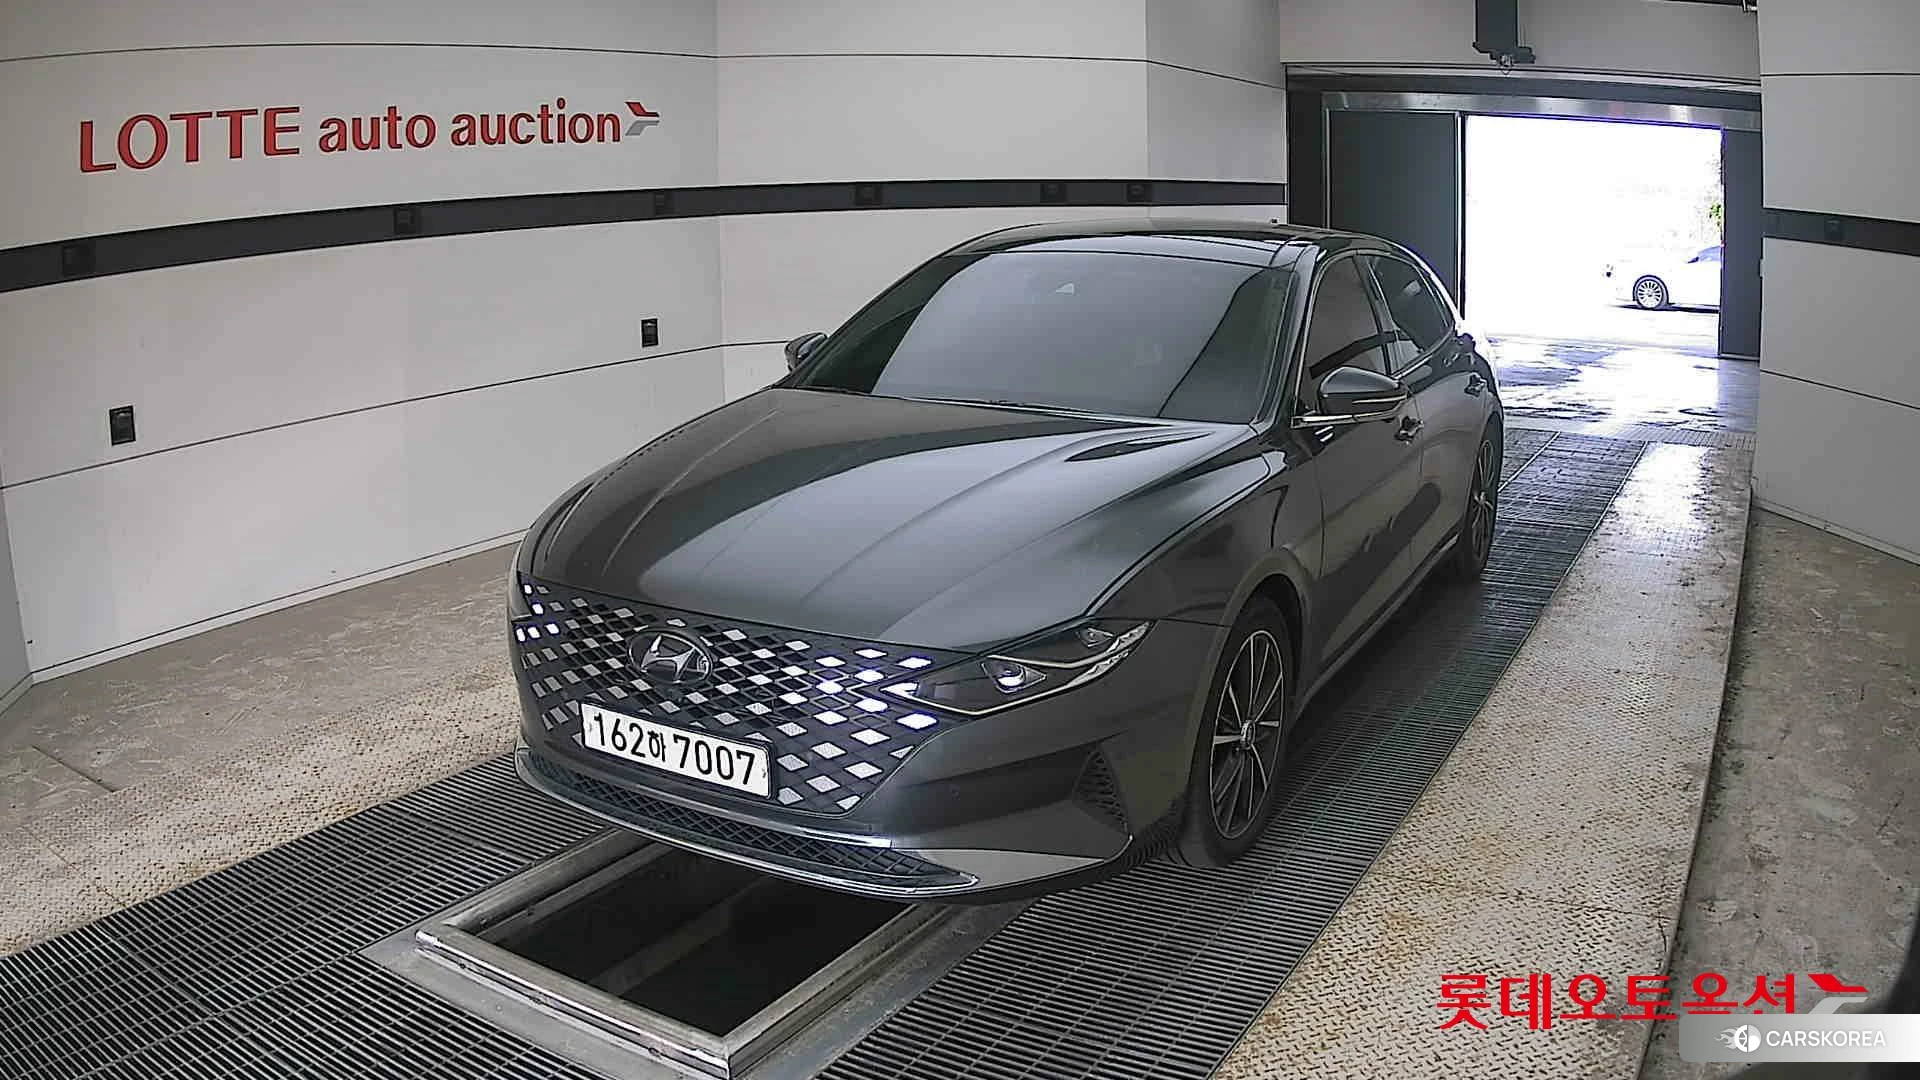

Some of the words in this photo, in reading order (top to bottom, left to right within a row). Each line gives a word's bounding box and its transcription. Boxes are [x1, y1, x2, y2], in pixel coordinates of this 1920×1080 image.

[79, 107, 301, 173] LOTTE
[318, 105, 436, 153] auto
[451, 98, 622, 147] auction
